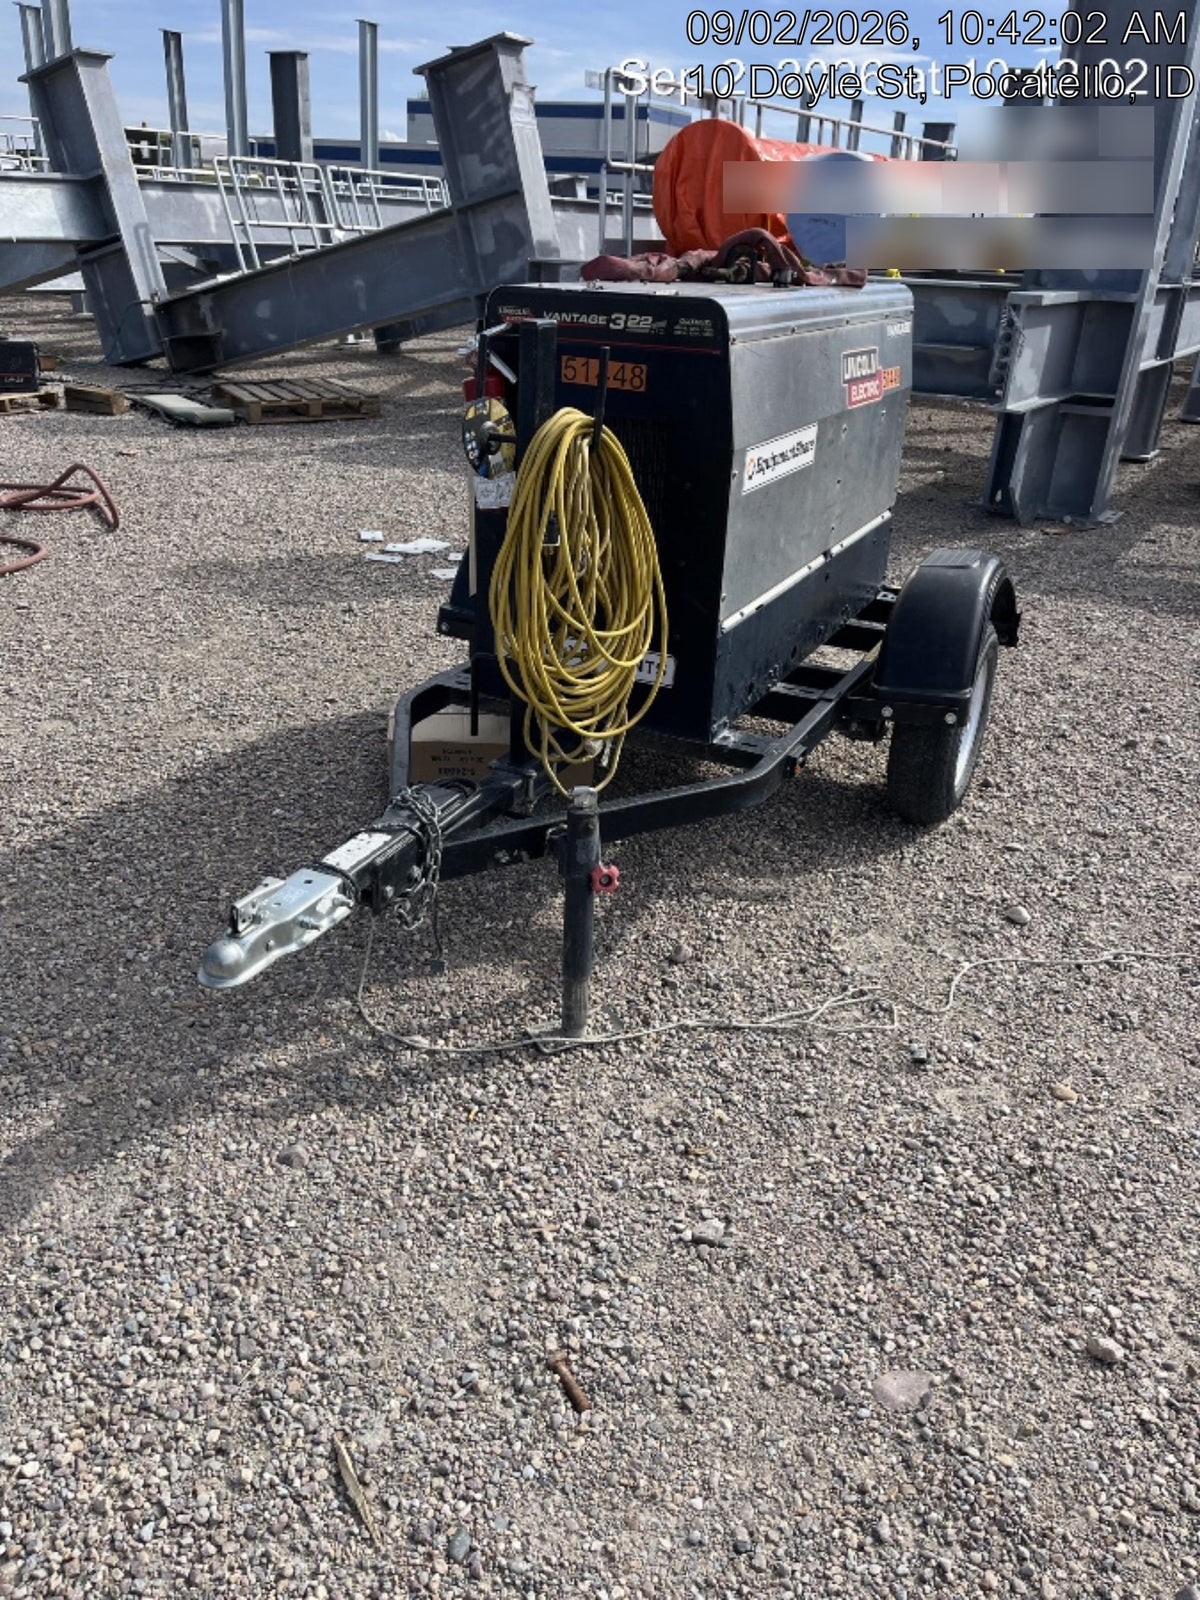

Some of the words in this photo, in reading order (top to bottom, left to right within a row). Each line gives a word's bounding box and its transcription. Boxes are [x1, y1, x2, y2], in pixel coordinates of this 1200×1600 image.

[544, 310, 608, 325] VANTAGE
[609, 313, 653, 330] 322
[563, 357, 646, 390] 5148
[844, 354, 877, 380] LINCOLN
[851, 379, 880, 402] ELECTRIC
